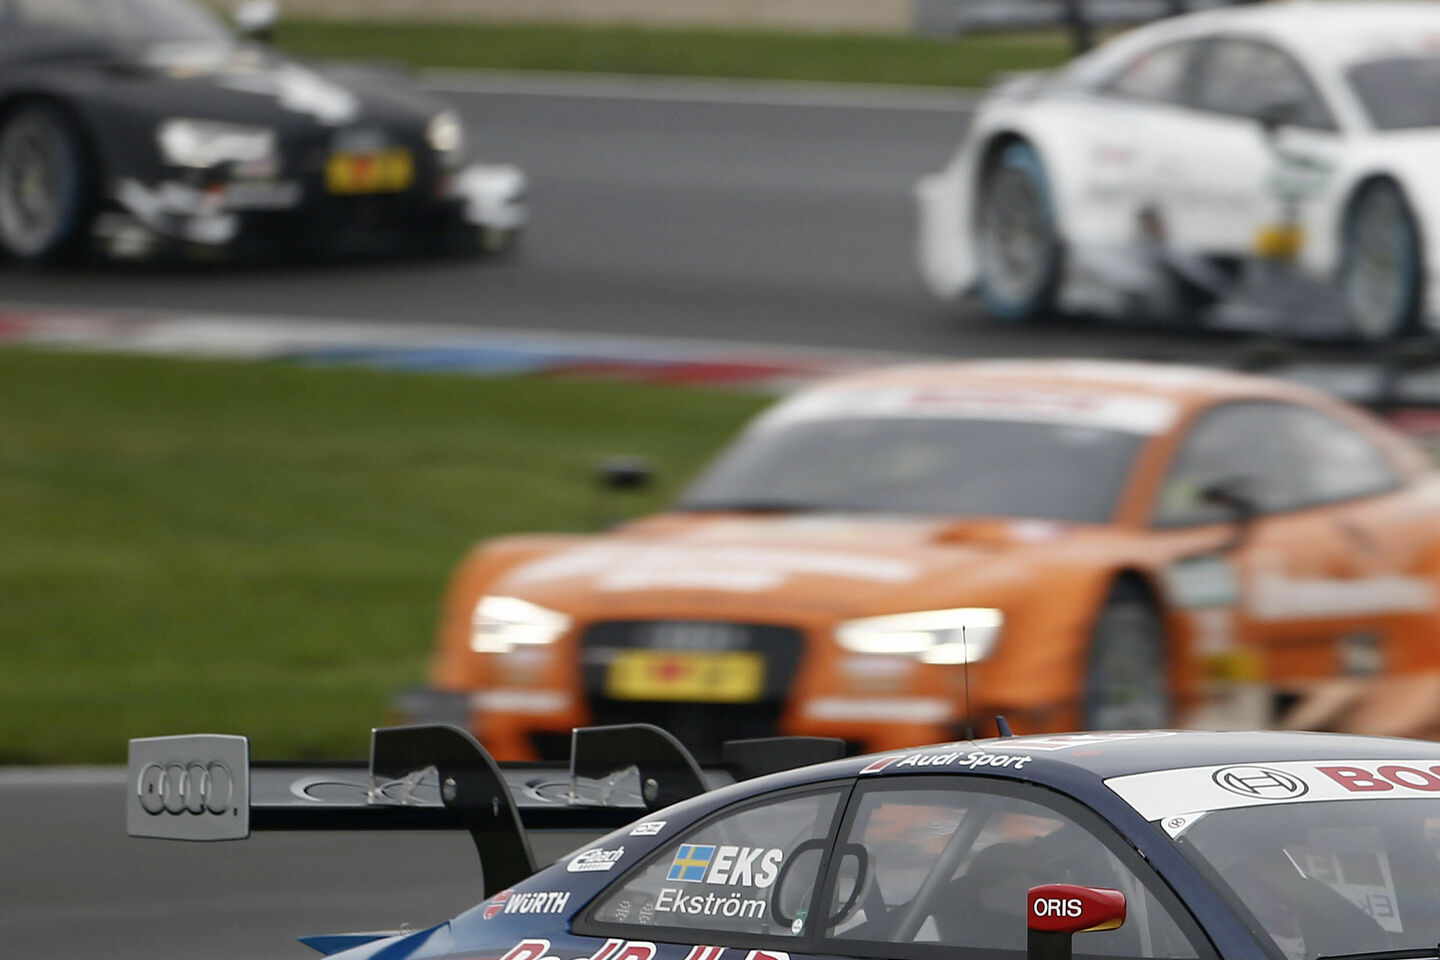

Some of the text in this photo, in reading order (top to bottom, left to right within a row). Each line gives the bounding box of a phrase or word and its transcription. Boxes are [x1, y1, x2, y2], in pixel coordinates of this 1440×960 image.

[896, 751, 1032, 770] Audi Sport
[706, 846, 783, 888] EKS
[504, 891, 571, 914] WÜRTH
[655, 888, 767, 919] Ekström
[1033, 898, 1083, 917] ORIS
